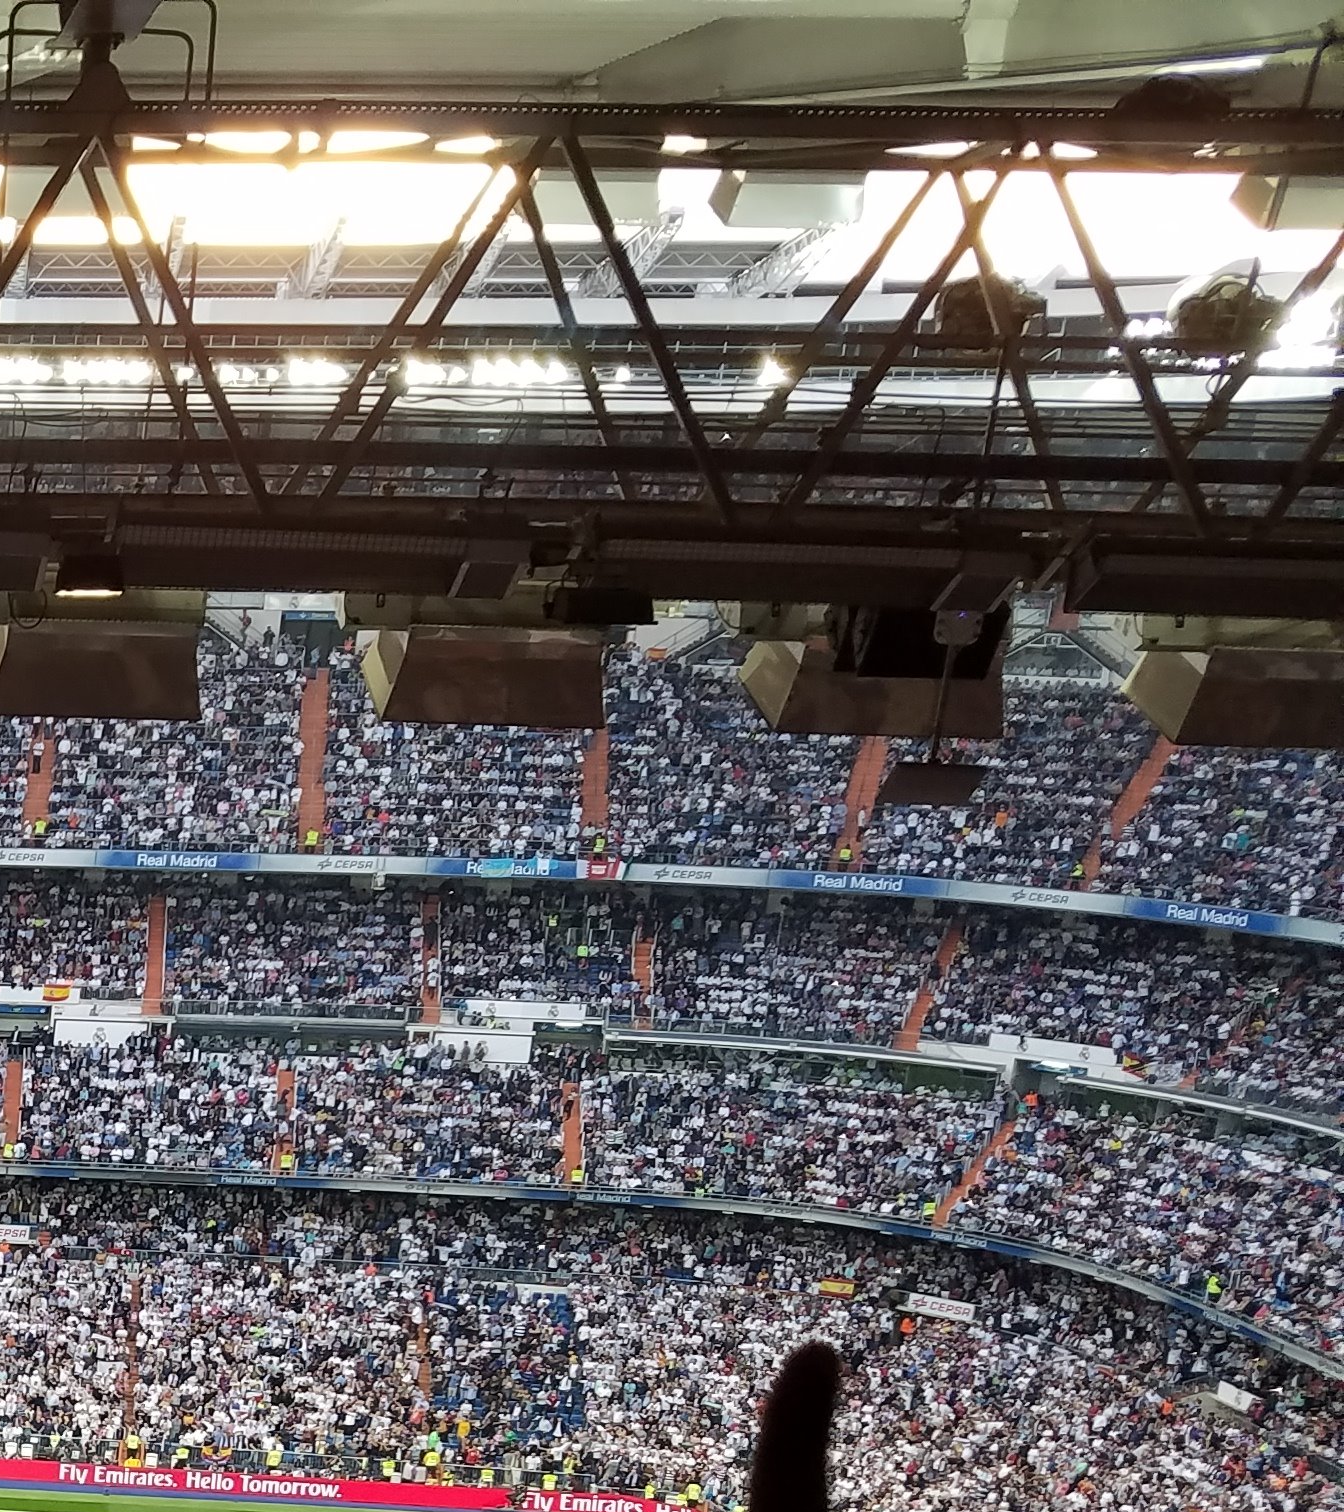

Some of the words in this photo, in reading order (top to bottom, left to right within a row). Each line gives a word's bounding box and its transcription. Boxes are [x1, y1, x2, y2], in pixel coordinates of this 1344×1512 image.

[8, 852, 44, 862] CEPSA
[137, 853, 166, 866] Real
[170, 855, 217, 868] Madrid
[336, 859, 372, 869] CEPSA
[671, 869, 712, 879] CEPSA
[813, 874, 843, 888] Real
[847, 876, 902, 891] Madrid
[1028, 892, 1069, 905] CEPSA
[1166, 904, 1192, 919] Real
[1196, 907, 1249, 927] Madrid
[243, 1176, 277, 1186] Madrid
[598, 1194, 631, 1203] Madrid
[929, 1303, 971, 1316] CEPSA
[59, 1464, 88, 1484] Fly
[94, 1467, 177, 1488] Emirates.
[186, 1472, 233, 1491] Hello
[241, 1475, 341, 1498] Tomorrow.
[523, 1492, 554, 1512] Fly
